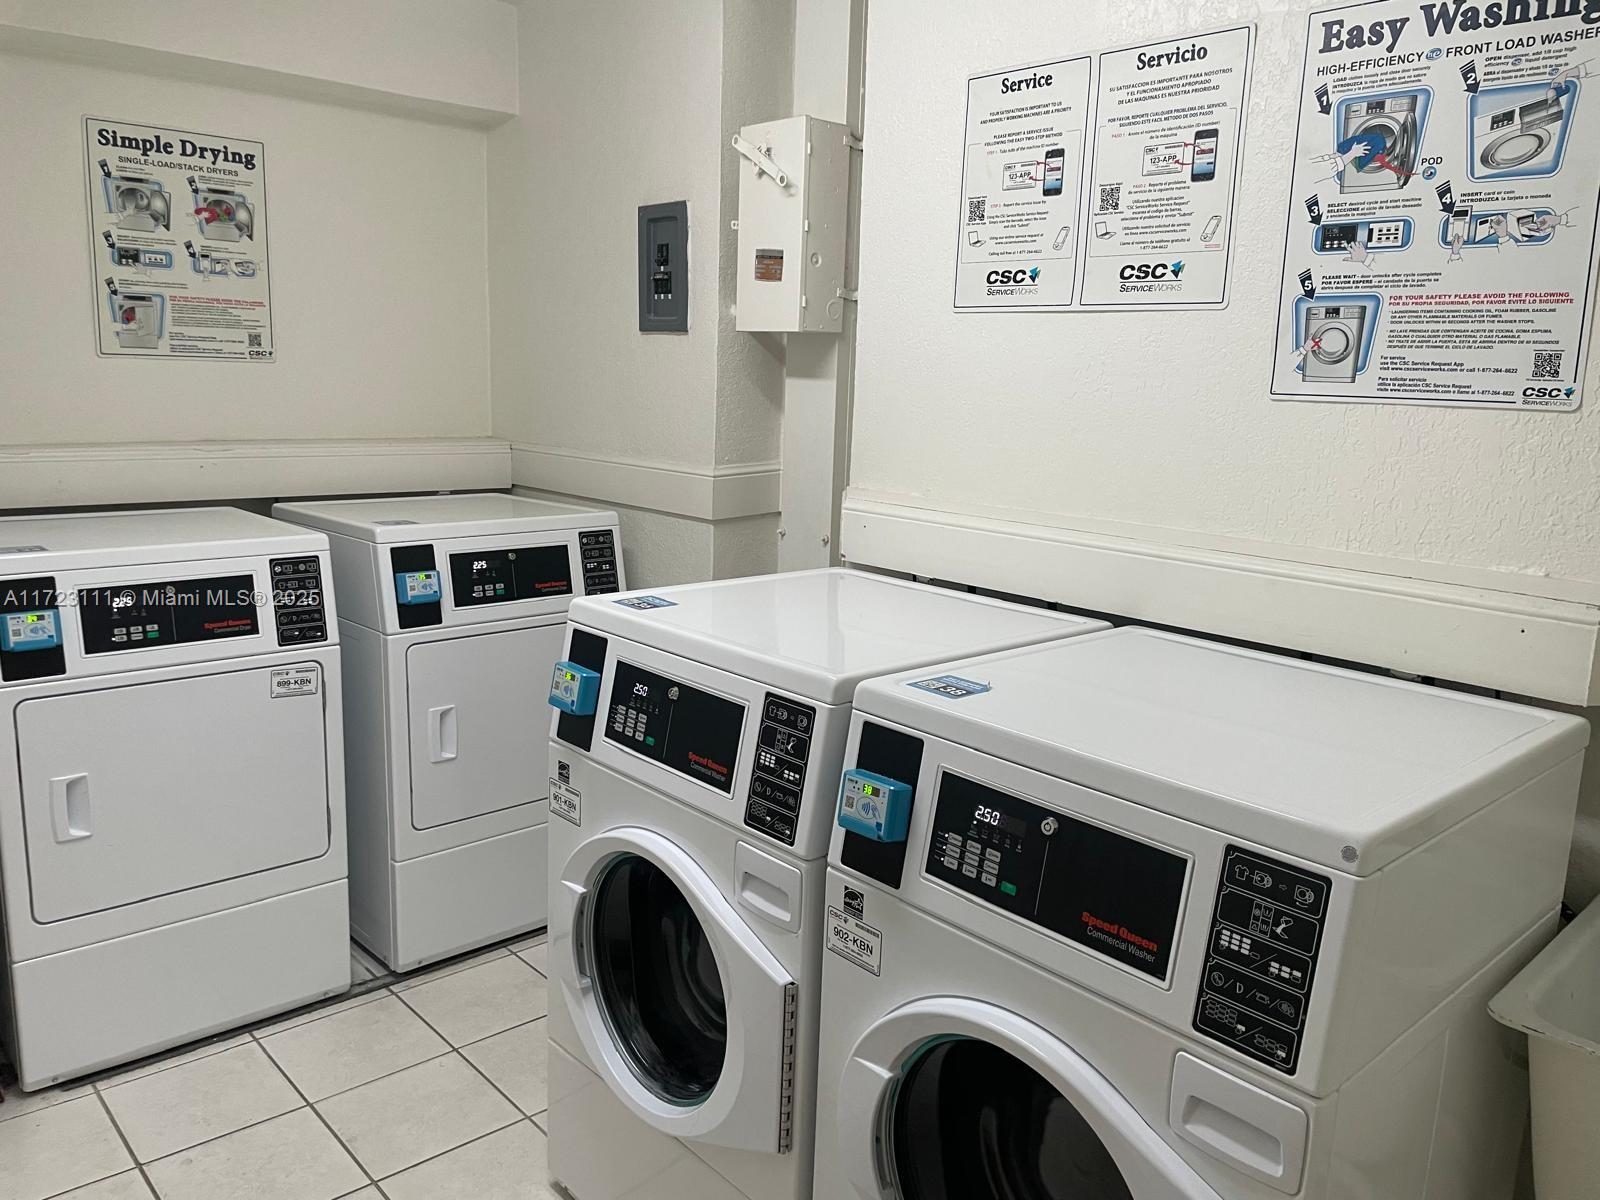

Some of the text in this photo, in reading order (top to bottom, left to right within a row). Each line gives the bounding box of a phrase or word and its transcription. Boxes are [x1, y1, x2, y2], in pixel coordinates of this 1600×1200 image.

[1318, 17, 1411, 53] Easy
[1446, 40, 1492, 57] FRONT
[1495, 35, 1536, 51] LOAD
[1136, 44, 1208, 71] Servicio
[1317, 51, 1424, 76] HIGH-EFFICIENCY
[1203, 67, 1232, 77] NOSOTROS
[1001, 73, 1053, 94] Service
[1167, 89, 1190, 97] NUESTRA
[97, 128, 256, 170] Simple Drying
[118, 155, 204, 172] SINGLE-LOAD/STACK
[206, 166, 238, 176] DRYERS
[1150, 153, 1178, 165] 123-APP
[1421, 156, 1443, 167] POD
[1310, 205, 1319, 217] 3
[986, 268, 1026, 284] CSC
[1119, 263, 1168, 280] CSC
[1304, 280, 1312, 291] 5
[1522, 387, 1561, 397] CSC
[276, 678, 312, 688] 899-KBN
[833, 926, 873, 956] 902-KBN
[1081, 911, 1158, 952] Speed Queen
[1086, 926, 1156, 963] Commercial Washer
